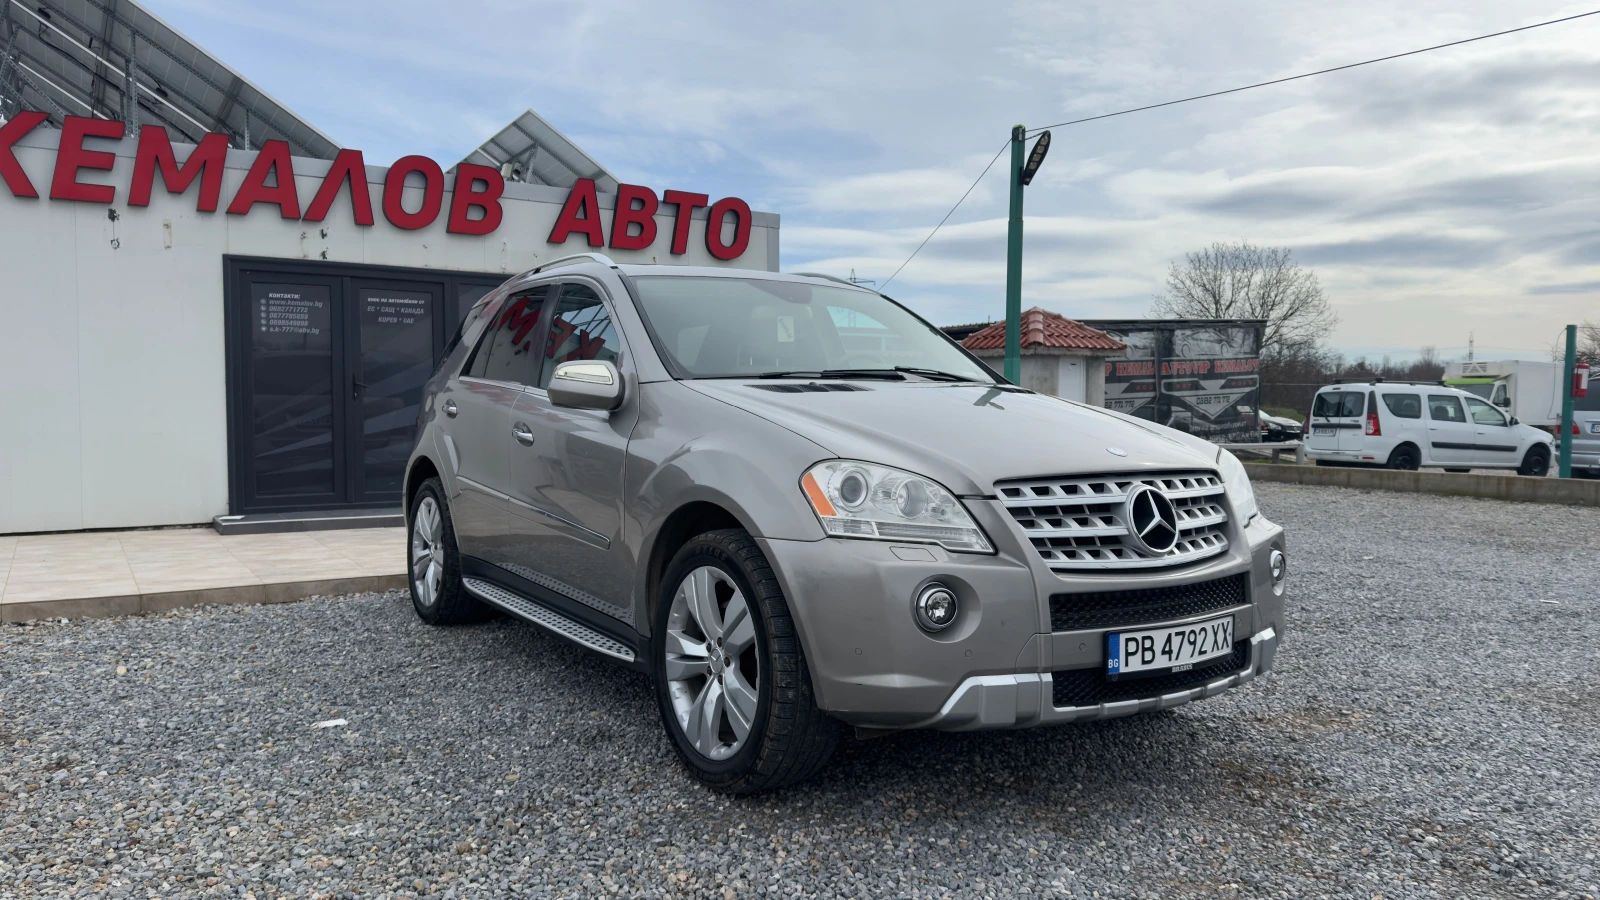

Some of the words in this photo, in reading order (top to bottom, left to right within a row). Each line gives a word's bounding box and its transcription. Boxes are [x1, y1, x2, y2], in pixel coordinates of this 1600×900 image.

[547, 178, 752, 260] АВТО
[380, 306, 395, 314] САЩ
[1116, 362, 1155, 376] KEMAL
[1160, 361, 1210, 376] AUTOVIP
[1214, 359, 1260, 373] KEMALOV
[1125, 635, 1155, 667] PB
[1161, 627, 1207, 662] 4792
[1211, 621, 1230, 653] XX
[1107, 658, 1119, 668] BG
